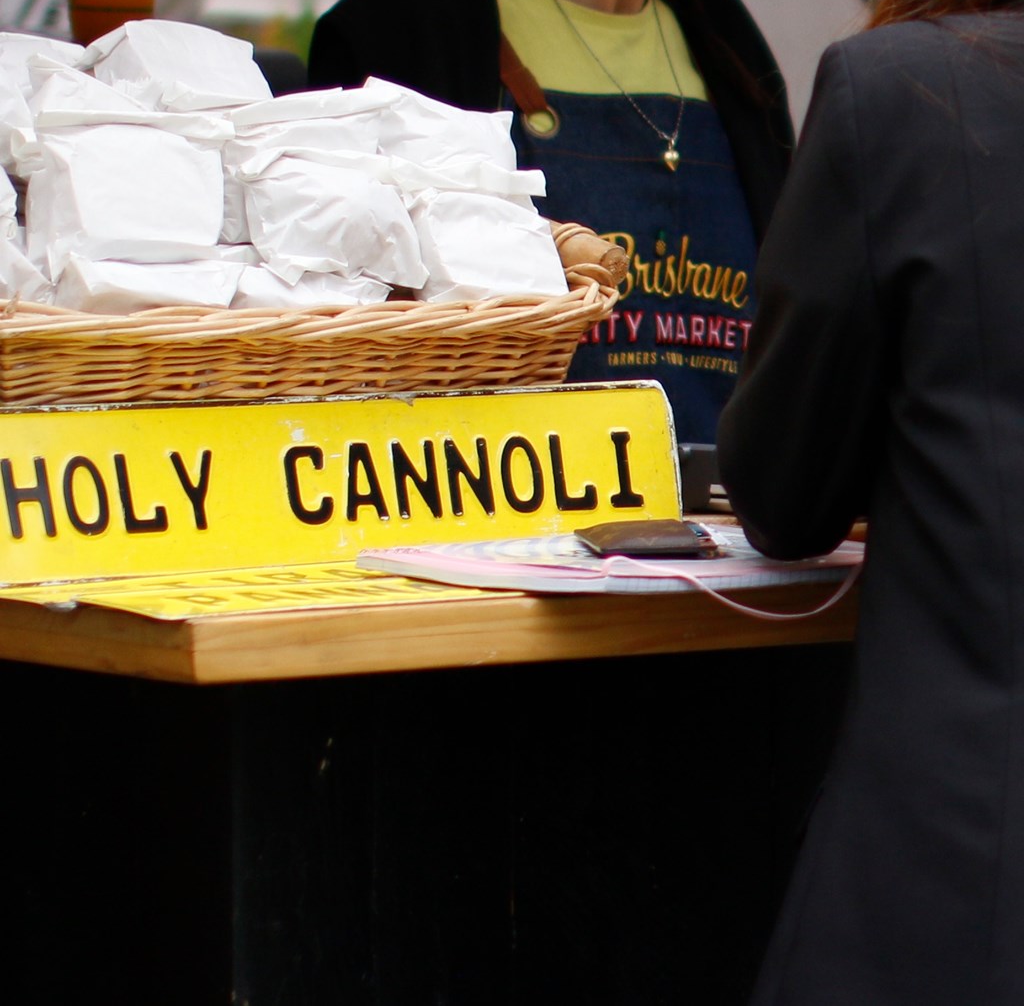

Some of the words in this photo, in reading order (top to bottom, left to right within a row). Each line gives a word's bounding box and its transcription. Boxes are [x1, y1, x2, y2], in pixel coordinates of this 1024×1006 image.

[579, 310, 645, 345] ITY
[607, 351, 657, 367] FARMERS
[0, 448, 213, 540] HOLY
[283, 430, 645, 526] CANNOLI
